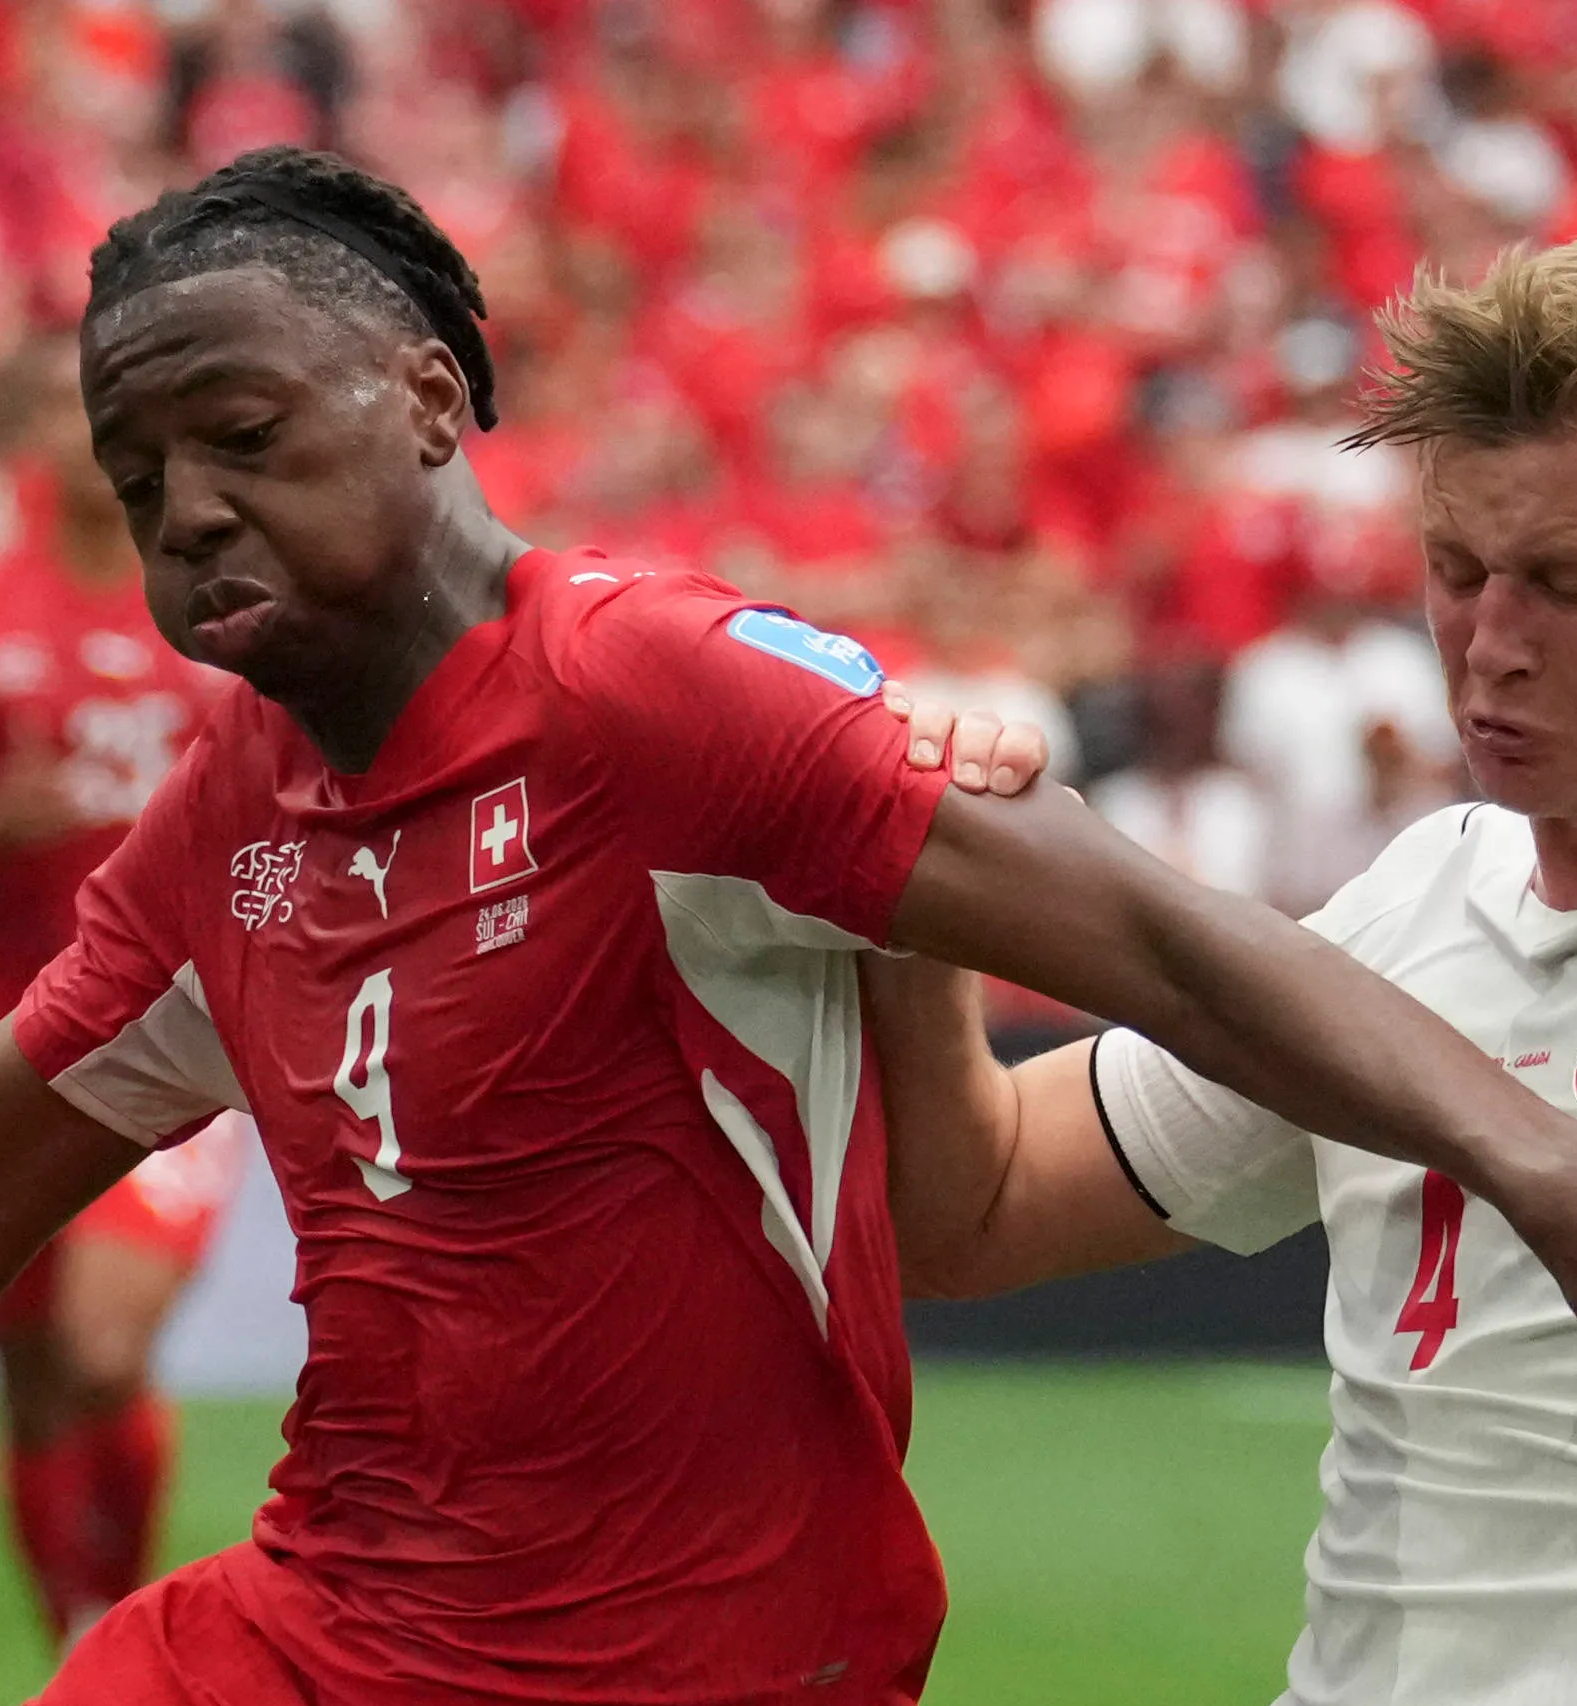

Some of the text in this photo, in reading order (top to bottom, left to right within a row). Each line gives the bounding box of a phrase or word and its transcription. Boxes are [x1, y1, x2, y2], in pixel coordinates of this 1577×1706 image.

[476, 919, 495, 942] SUI
[334, 967, 413, 1202] 9
[1393, 1167, 1466, 1372] 4
